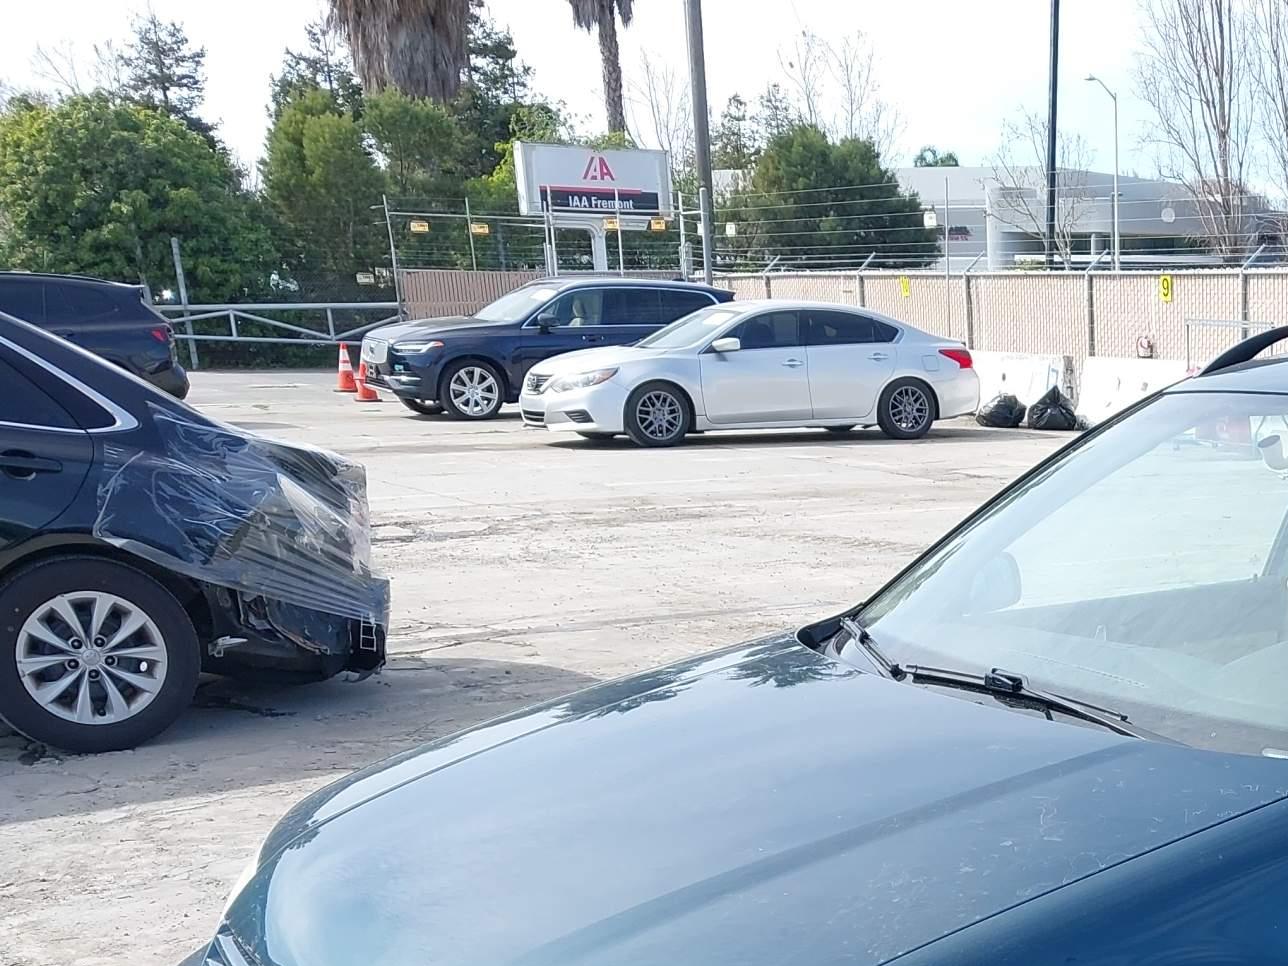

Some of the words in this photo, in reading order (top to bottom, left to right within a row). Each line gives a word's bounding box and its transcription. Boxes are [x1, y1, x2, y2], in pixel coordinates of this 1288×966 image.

[568, 195, 589, 208] IAA
[591, 196, 634, 209] Fremont
[1162, 277, 1170, 297] 9
